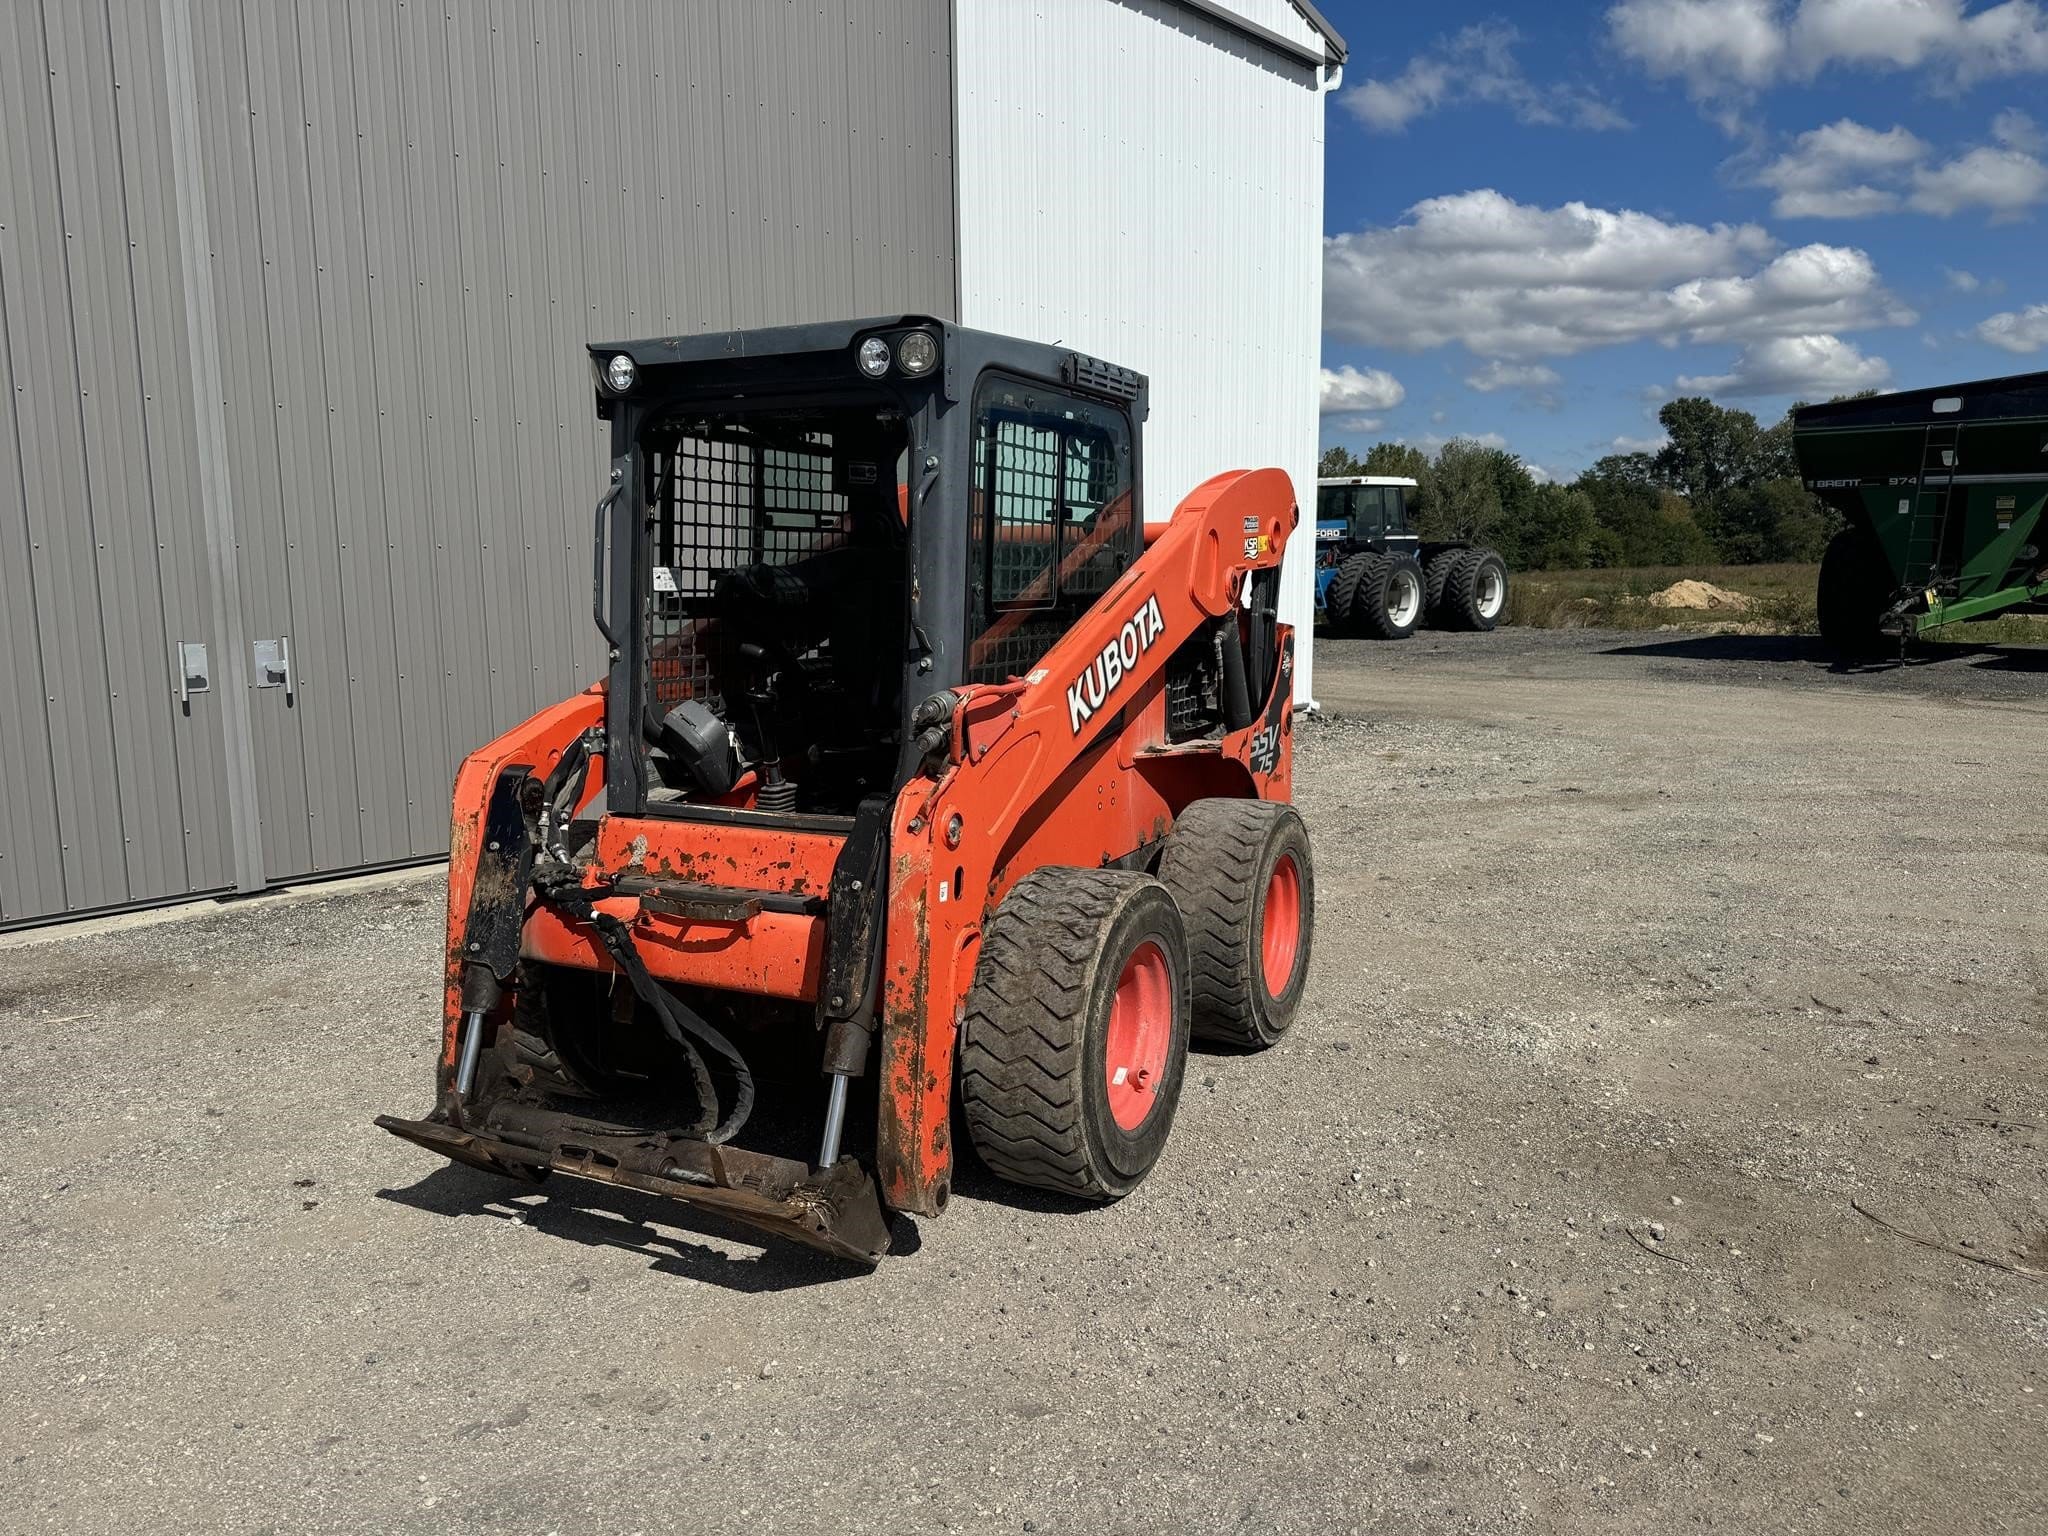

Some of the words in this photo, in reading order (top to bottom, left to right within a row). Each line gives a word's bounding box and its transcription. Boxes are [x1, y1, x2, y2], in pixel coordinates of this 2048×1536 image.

[1816, 478, 1862, 488] BRENT
[1888, 476, 1917, 486] 974
[1066, 593, 1165, 735] KUBOTA
[1250, 723, 1280, 758] SSV
[1258, 752, 1274, 774] 75
